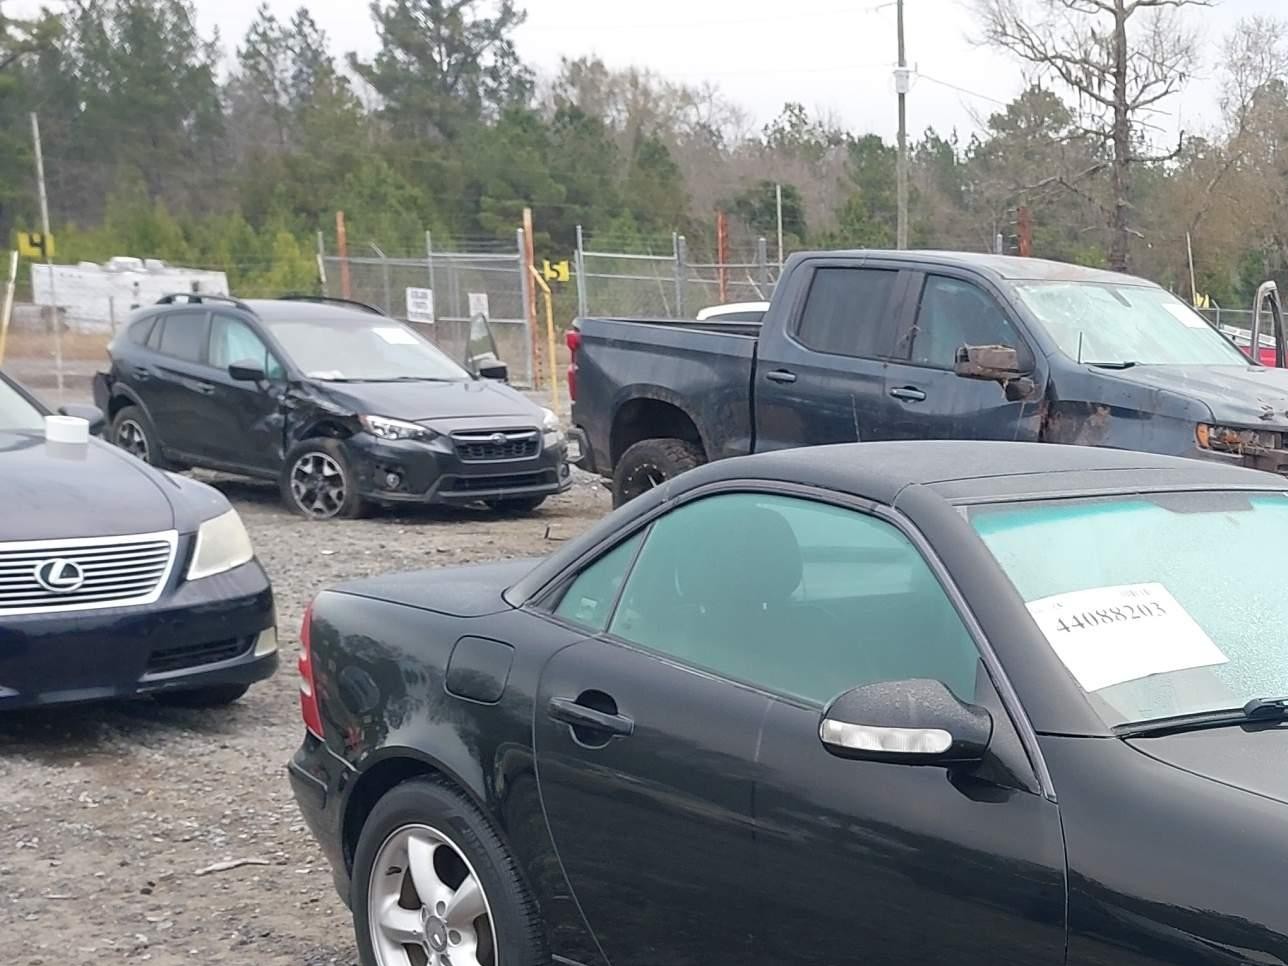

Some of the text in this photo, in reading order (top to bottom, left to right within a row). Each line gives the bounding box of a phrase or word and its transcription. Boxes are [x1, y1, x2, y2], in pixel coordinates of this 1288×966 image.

[29, 231, 47, 257] 4
[548, 260, 562, 280] 5
[1056, 601, 1167, 633] 44088203
